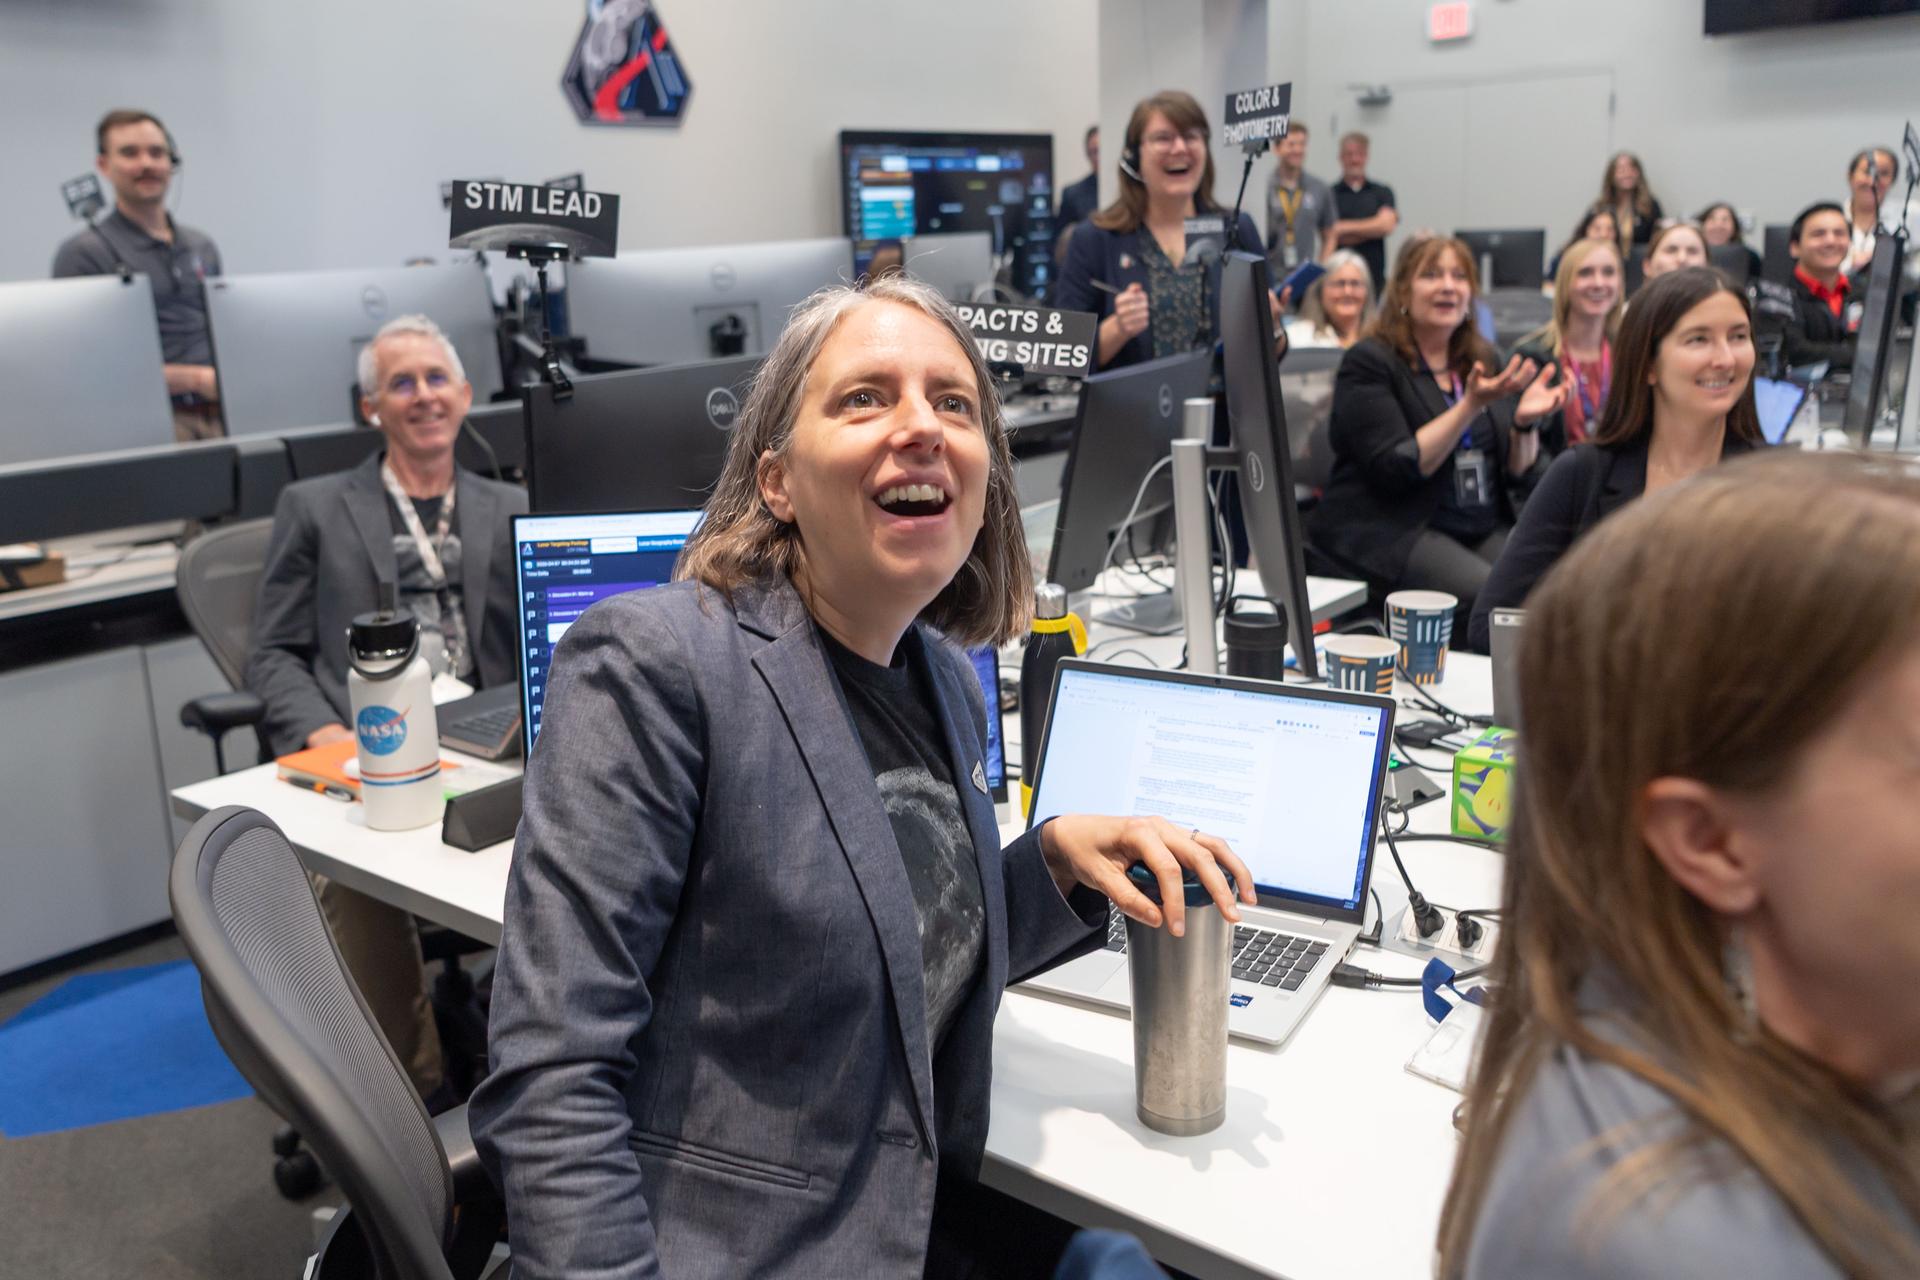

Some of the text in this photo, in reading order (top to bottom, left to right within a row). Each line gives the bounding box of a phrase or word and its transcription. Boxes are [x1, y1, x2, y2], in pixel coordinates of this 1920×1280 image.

[1235, 86, 1280, 114] COLOR &
[1224, 114, 1290, 144] PHOTOMETRY
[465, 182, 602, 219] STM LEAD
[952, 306, 1063, 335] PACTS &
[1015, 342, 1089, 368] SITES
[360, 724, 403, 738] NASA
